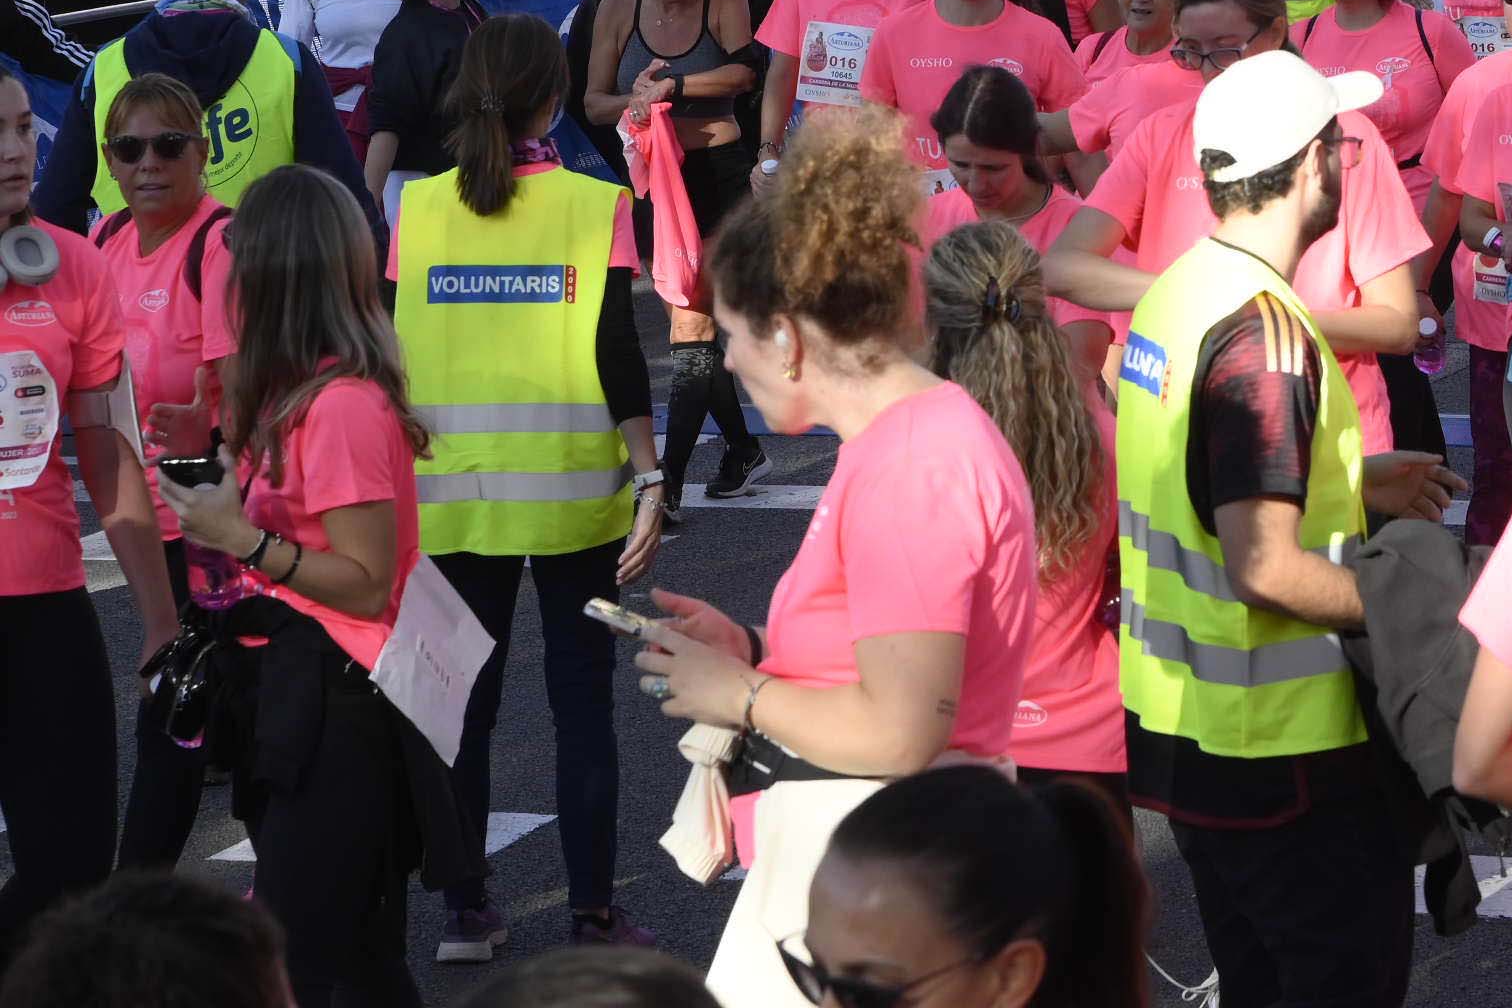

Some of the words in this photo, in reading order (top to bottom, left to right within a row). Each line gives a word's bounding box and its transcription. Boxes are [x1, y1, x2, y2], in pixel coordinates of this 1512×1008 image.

[1471, 42, 1496, 53] 016
[829, 56, 858, 70] 016
[909, 57, 953, 69] OYSHO
[831, 70, 853, 81] 10645
[431, 275, 560, 294] VOLUNTARIS
[12, 368, 42, 378] SUMA
